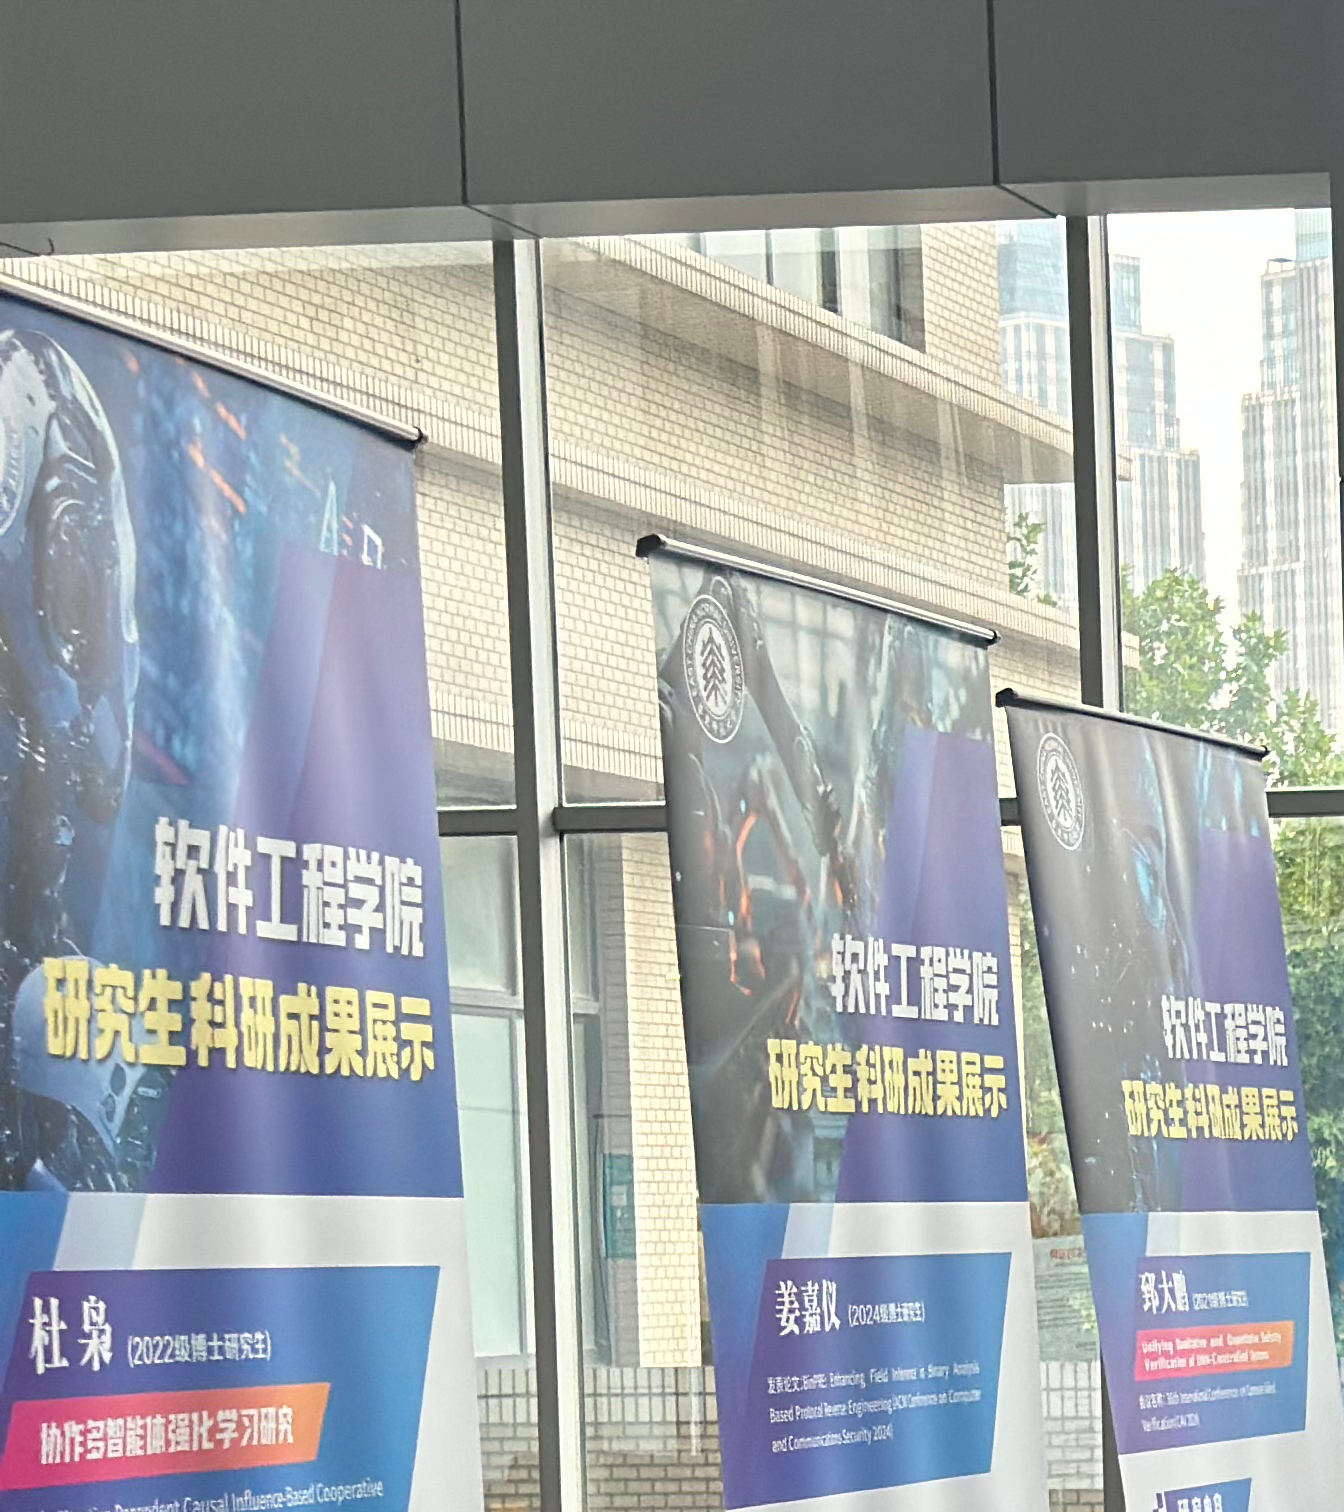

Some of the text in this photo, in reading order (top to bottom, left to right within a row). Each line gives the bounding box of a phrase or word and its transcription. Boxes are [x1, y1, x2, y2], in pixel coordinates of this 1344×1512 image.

[154, 816, 425, 957] 软件工程学院
[831, 932, 999, 1026] 软件工程学院
[43, 957, 435, 1081] 研究生科研成果展示
[1159, 993, 1289, 1066] 软件工程学院
[766, 1038, 1007, 1118] 研究生科研成果展示
[1121, 1079, 1299, 1143] 研究生科研成果展示
[774, 1279, 841, 1336] 姜嘉仪
[127, 1331, 272, 1368] (2022级博士研究生)
[40, 1405, 294, 1465] 协作多智能体强化学习研究
[769, 1405, 794, 1424] Based
[316, 1477, 384, 1510] Cooperative
